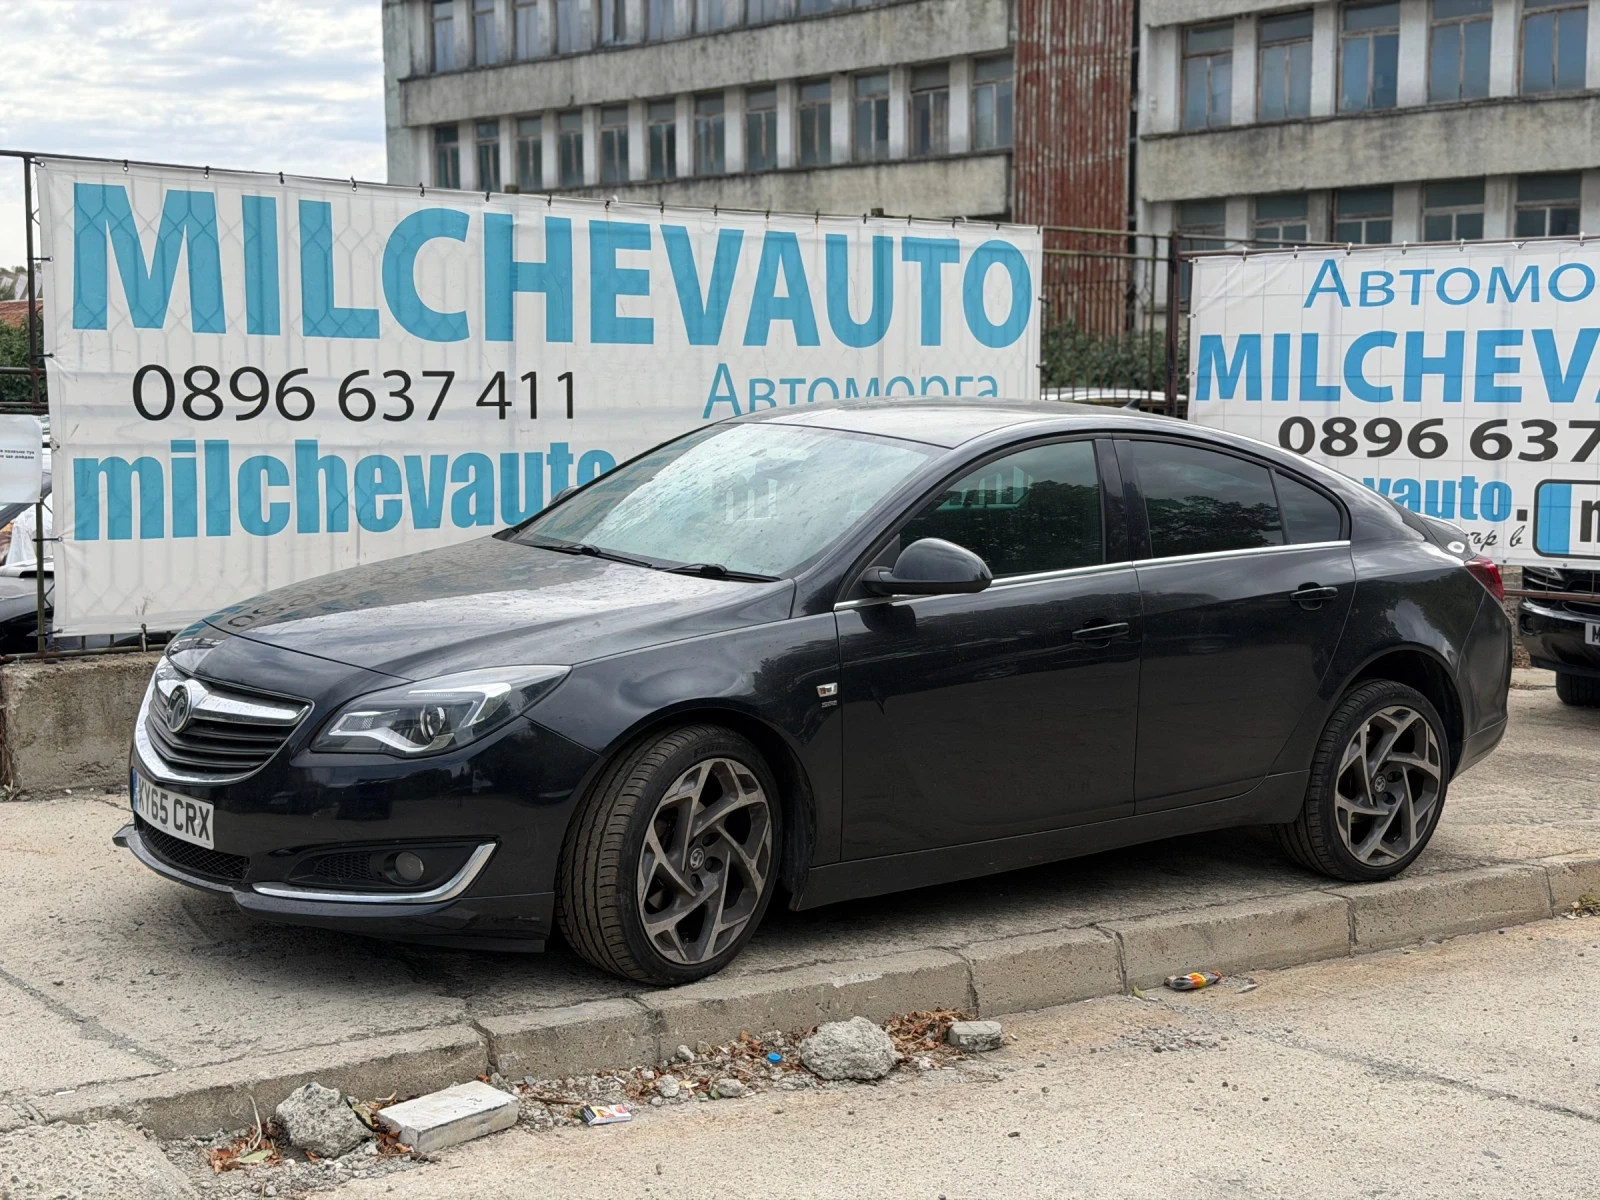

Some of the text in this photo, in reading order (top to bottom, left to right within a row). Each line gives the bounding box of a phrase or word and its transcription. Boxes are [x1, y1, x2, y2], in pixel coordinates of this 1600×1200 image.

[73, 182, 1032, 349] MILCHEVAUTO
[1303, 259, 1596, 308] Автомо
[1195, 328, 1600, 404] MILCHEV
[132, 364, 574, 422] 0896 637 411
[1278, 416, 1600, 463] 0896 637
[174, 798, 210, 841] CRX
